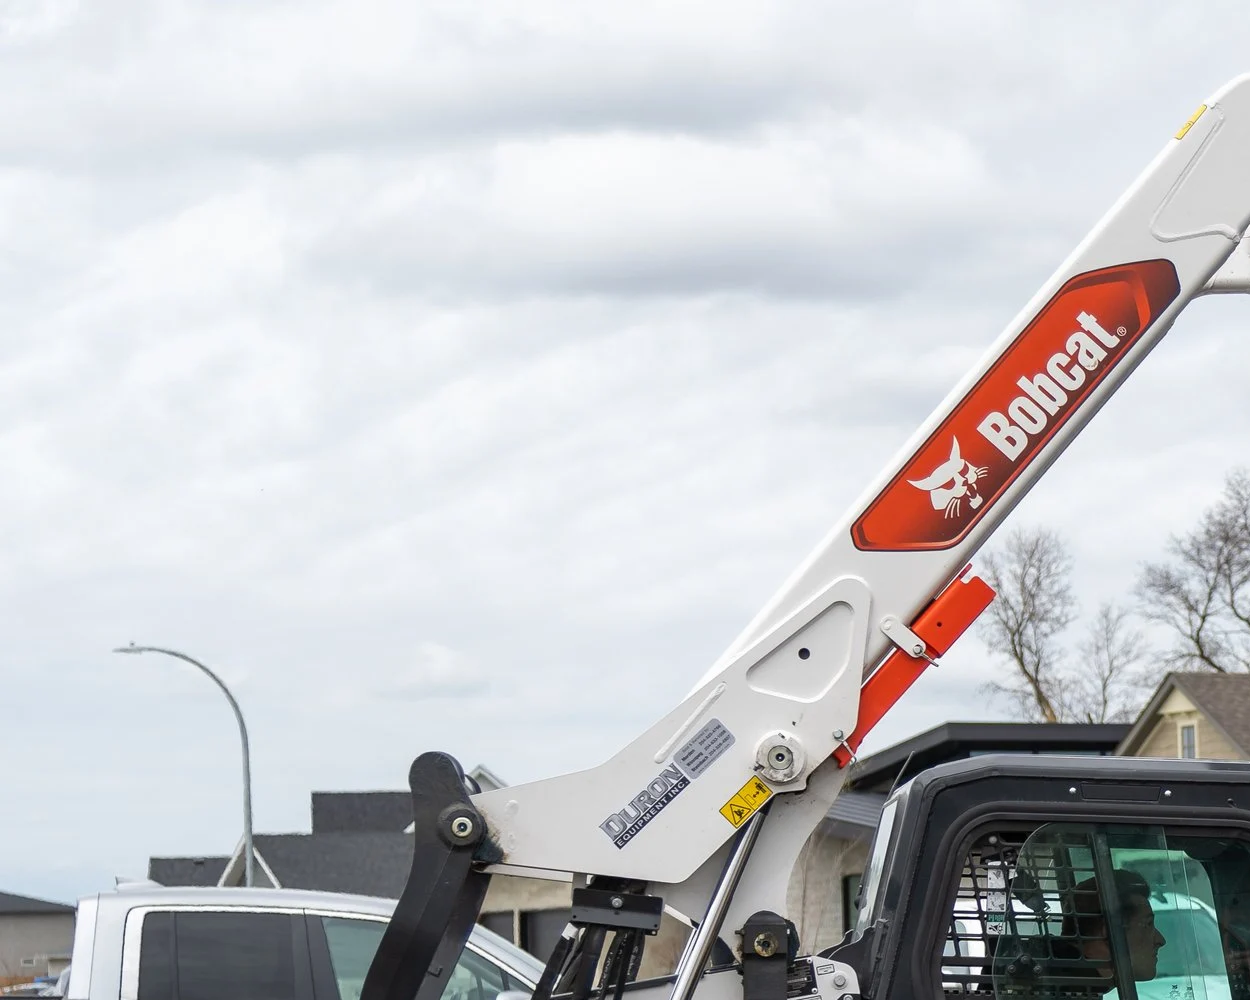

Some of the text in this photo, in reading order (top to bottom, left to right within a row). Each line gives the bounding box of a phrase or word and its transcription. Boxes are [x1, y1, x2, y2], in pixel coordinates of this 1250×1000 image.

[976, 311, 1121, 462] Bobcat
[599, 763, 684, 841] DURON
[617, 780, 689, 846] EQUIPMENT INC.
